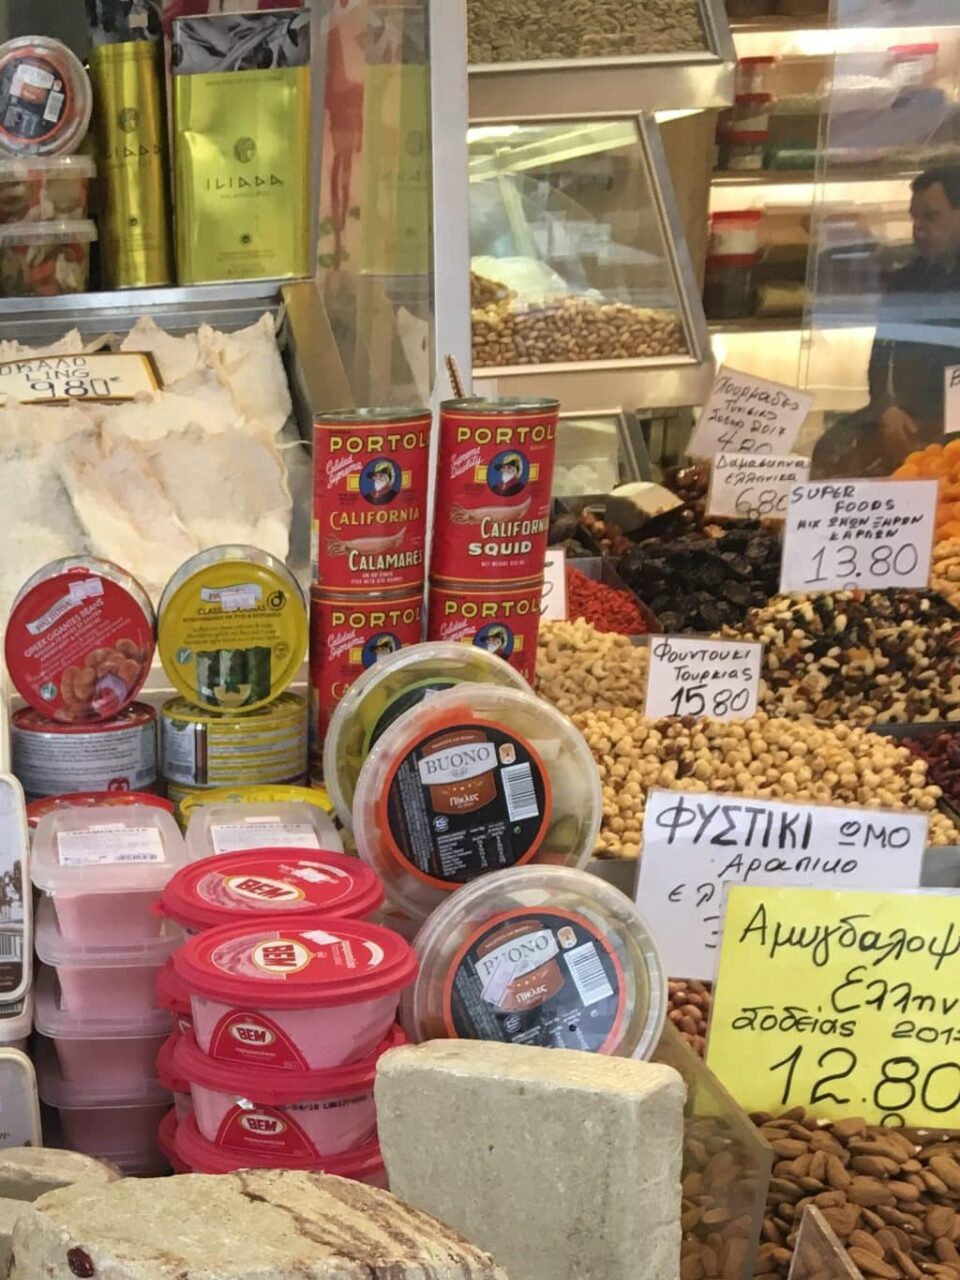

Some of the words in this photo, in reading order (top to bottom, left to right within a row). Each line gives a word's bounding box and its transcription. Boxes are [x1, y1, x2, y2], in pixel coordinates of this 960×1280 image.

[329, 431, 429, 454] PORTOL
[457, 424, 556, 445] PORTOL
[792, 485, 856, 503] SUPER
[834, 499, 896, 513] FOODS
[330, 507, 420, 531] CALIFORNIA
[468, 541, 532, 556] SQUID
[804, 543, 919, 584] 13.80
[331, 607, 421, 629] PORTOL
[444, 598, 540, 618] PORTOL
[425, 746, 490, 776] BUONO
[656, 796, 812, 849] ΦΥΣΤΙΚΙ
[770, 1045, 960, 1113] 12.80
